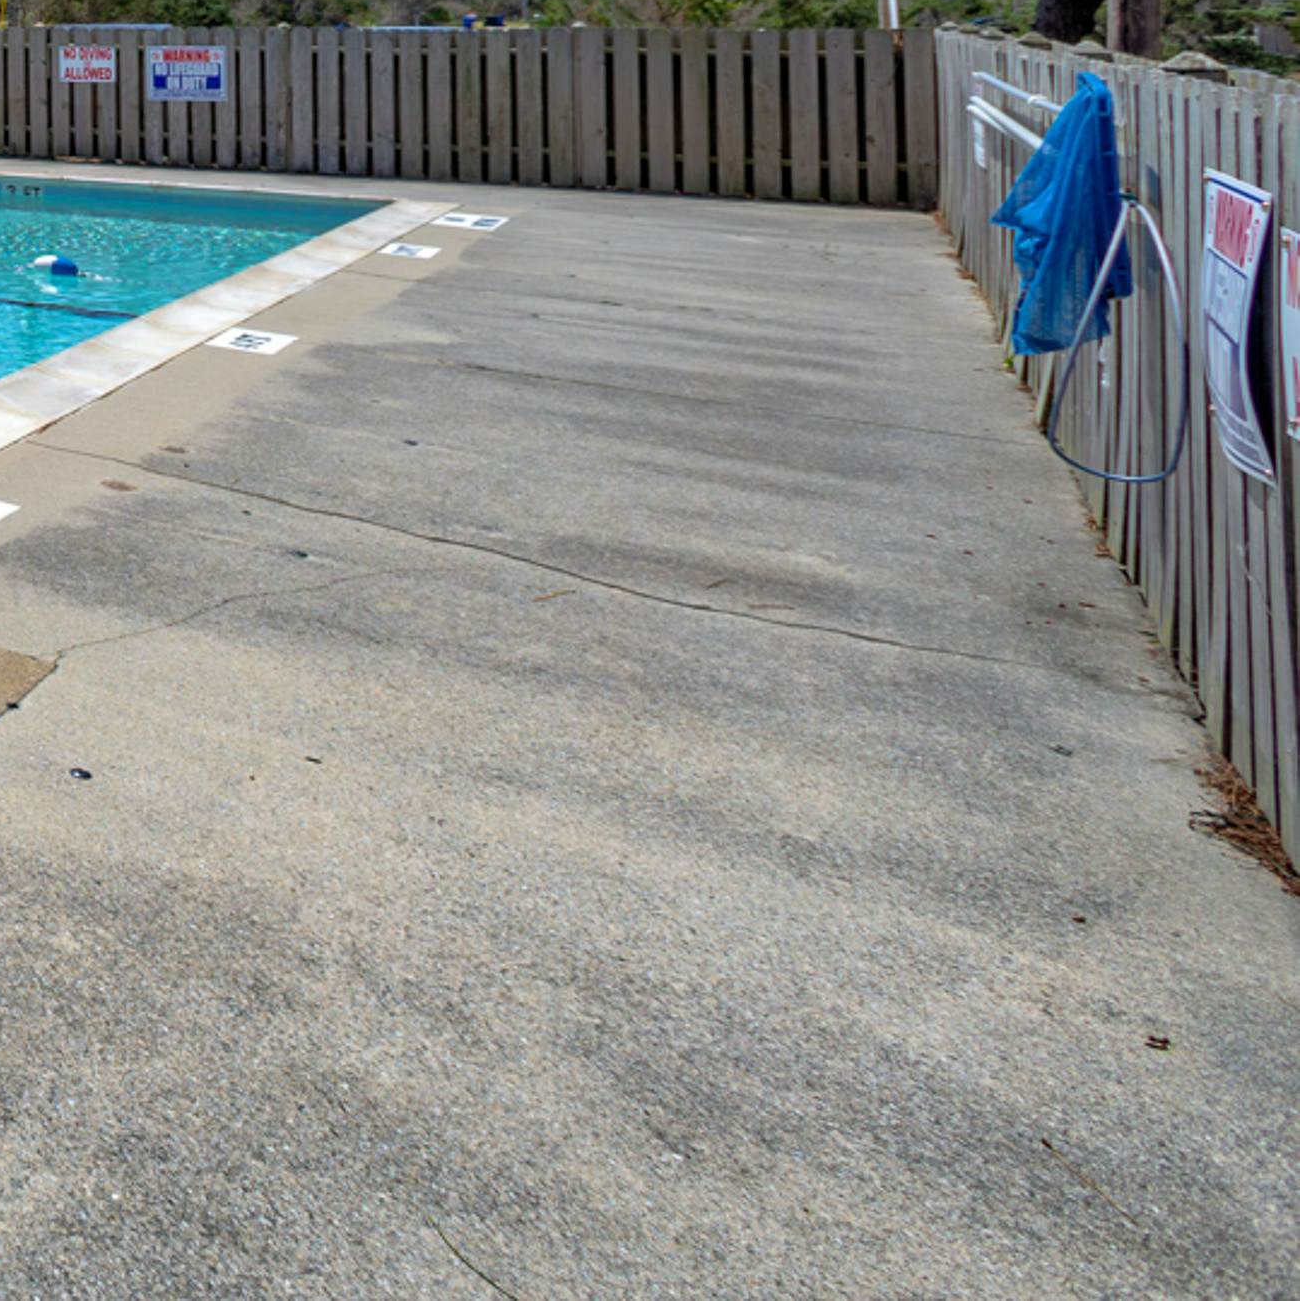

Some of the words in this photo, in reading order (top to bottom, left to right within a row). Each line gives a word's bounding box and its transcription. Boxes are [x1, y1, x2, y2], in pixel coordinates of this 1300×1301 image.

[63, 46, 76, 60] NO
[80, 44, 112, 60] DIVING
[163, 50, 210, 63] WARNING
[65, 66, 112, 80] ALLOWED
[155, 63, 168, 76] NO
[171, 63, 219, 76] LIFEGUARD
